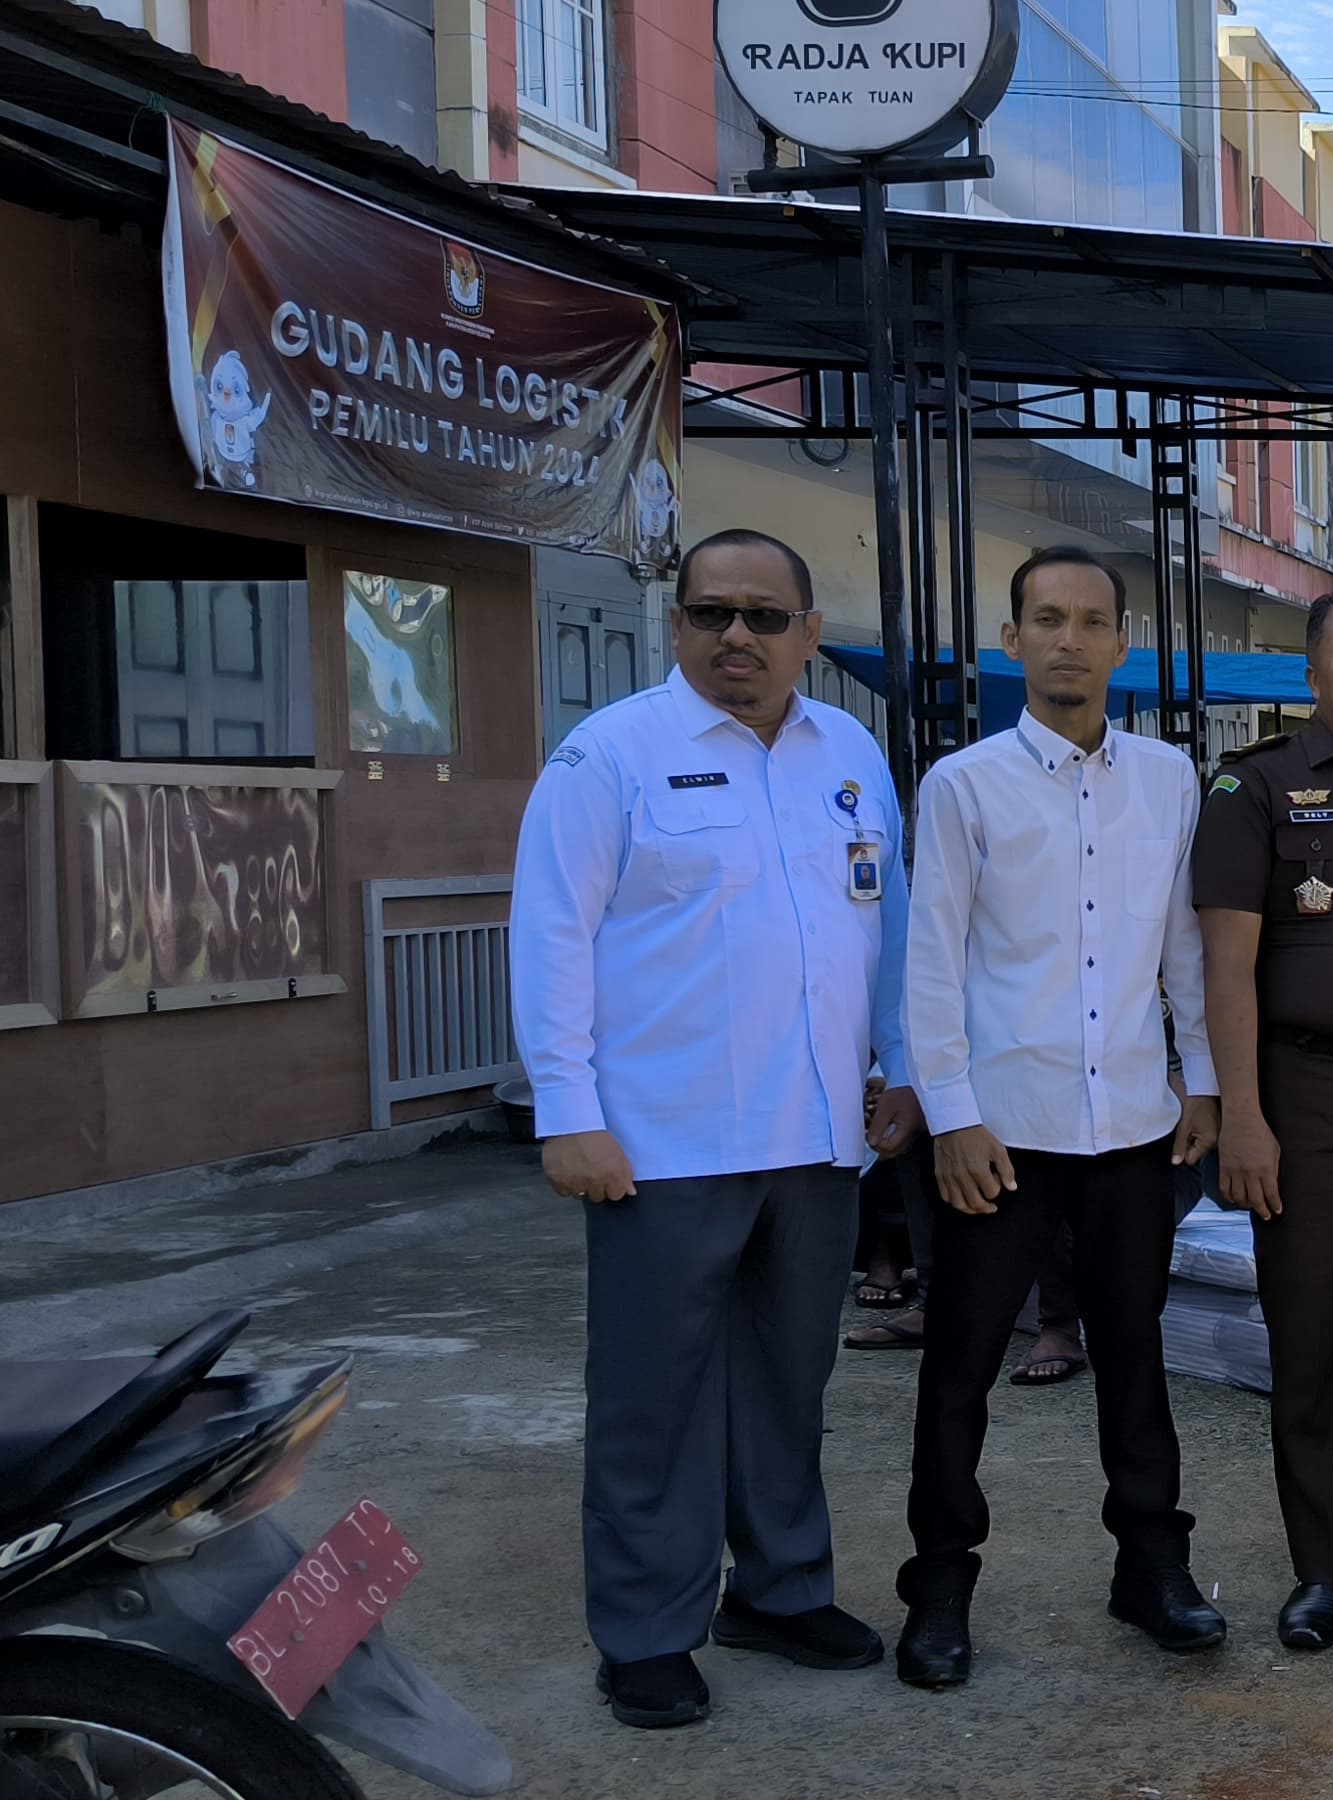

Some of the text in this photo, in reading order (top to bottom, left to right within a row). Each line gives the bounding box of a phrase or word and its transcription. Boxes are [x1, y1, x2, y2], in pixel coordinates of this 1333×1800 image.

[742, 42, 965, 70] RADJA KUPI
[794, 91, 913, 104] TAPAK TUAN
[271, 301, 627, 440] GUDANG LOGISTIK
[310, 388, 599, 486] PEMILU TAHUN 2024
[236, 1630, 286, 1676] BL
[277, 1541, 348, 1626] 2087
